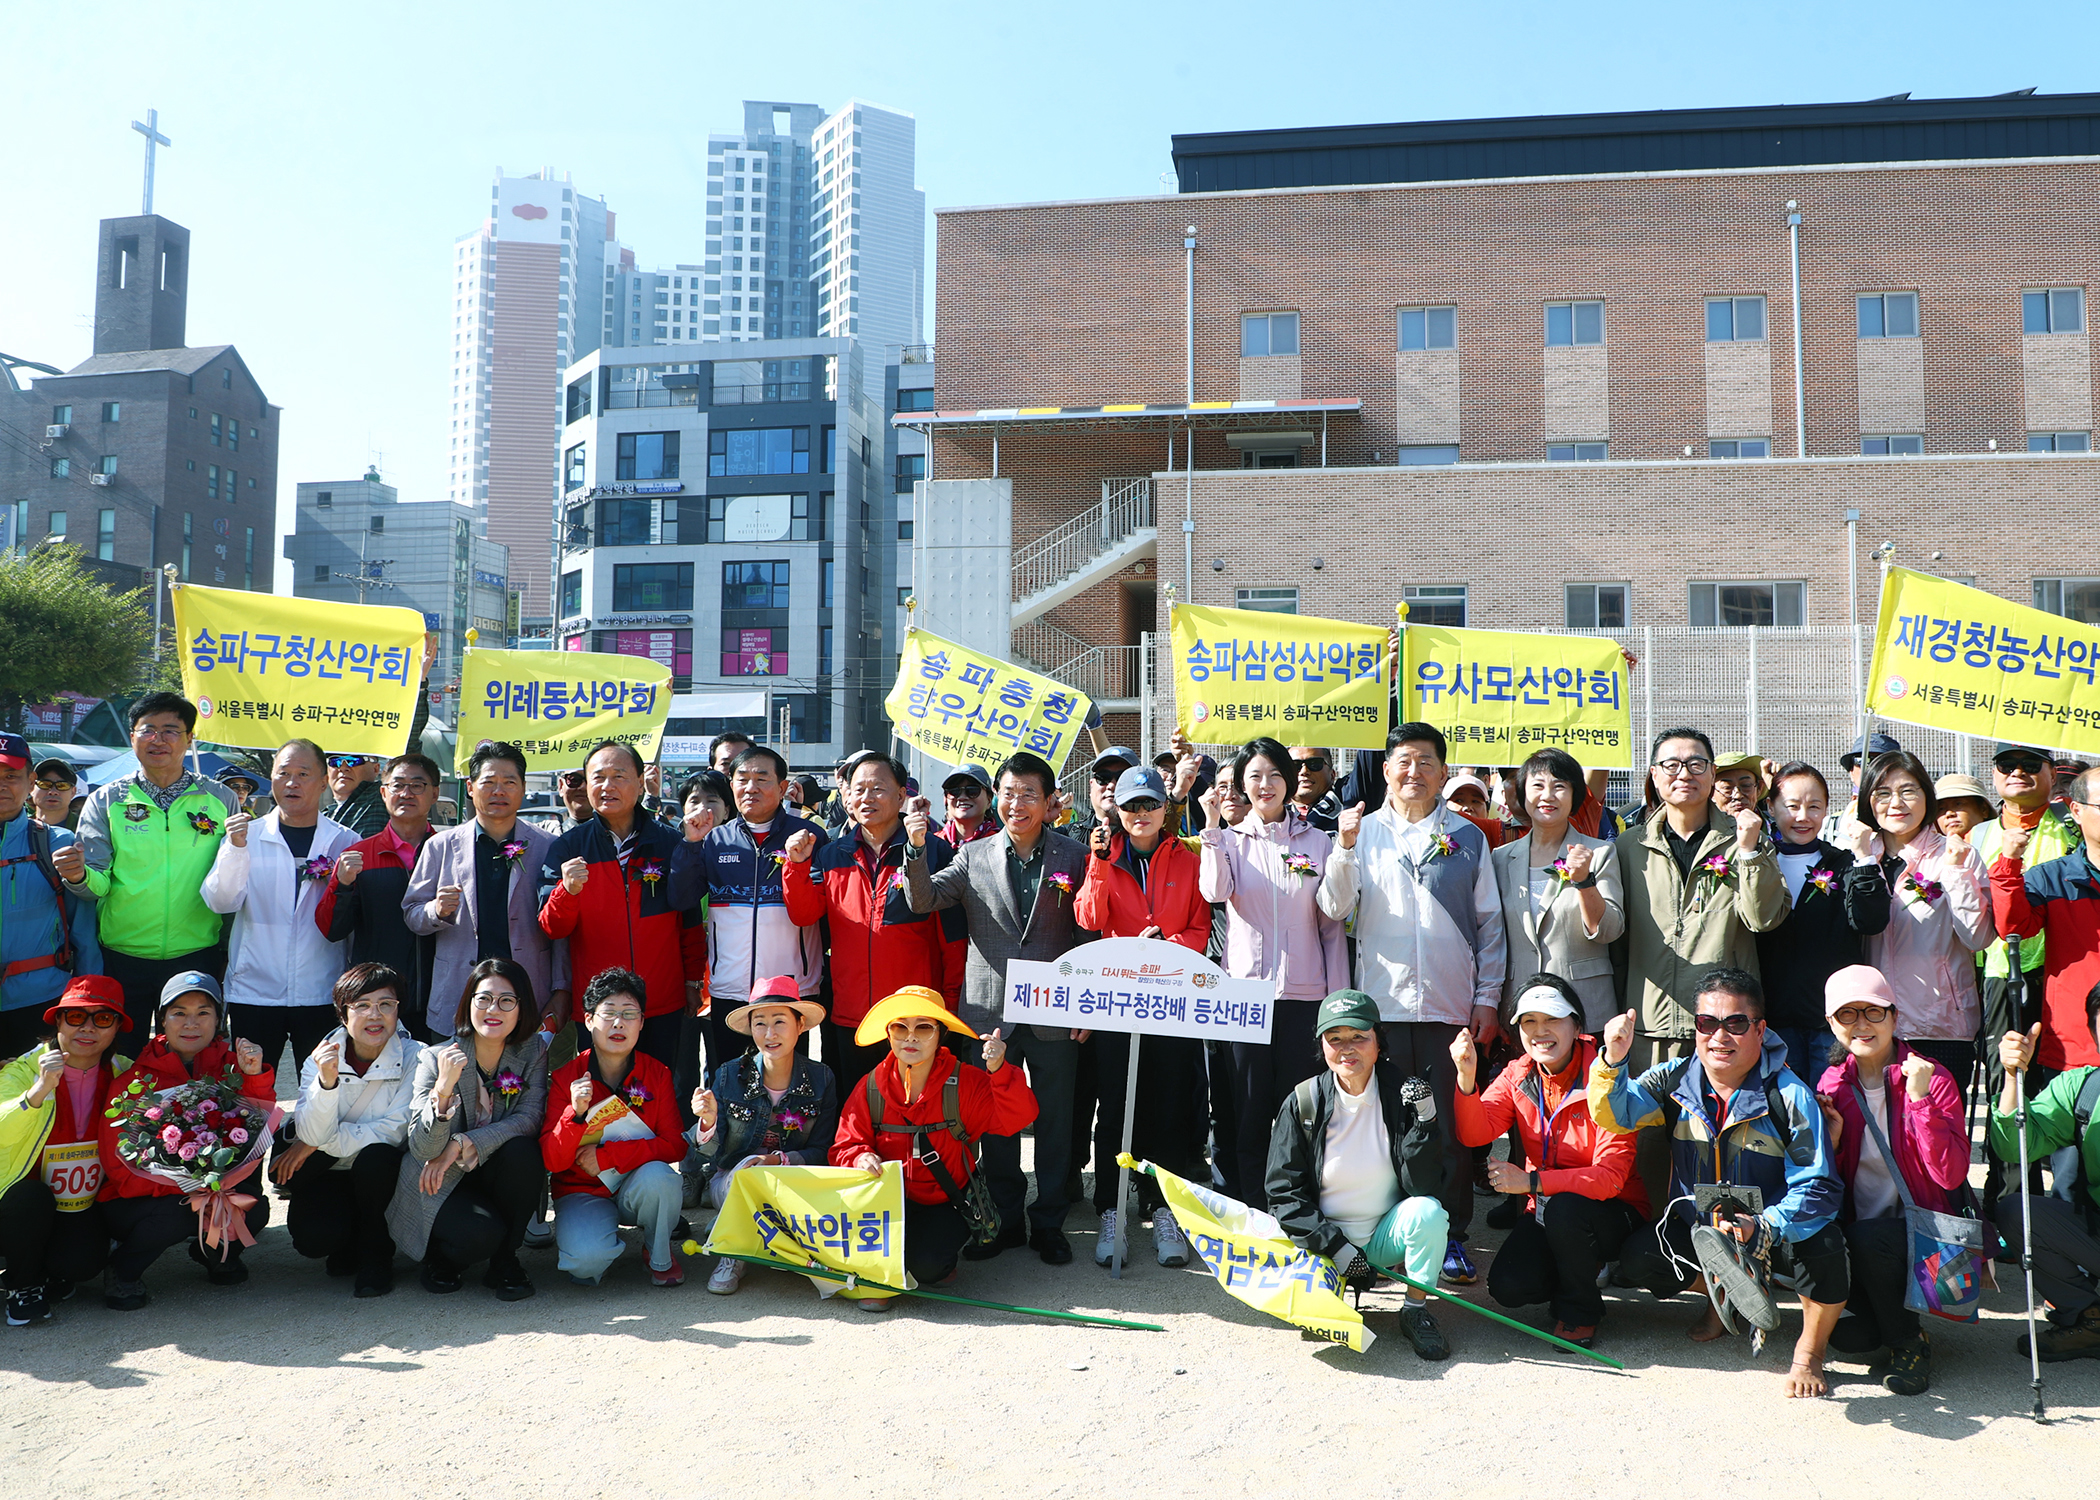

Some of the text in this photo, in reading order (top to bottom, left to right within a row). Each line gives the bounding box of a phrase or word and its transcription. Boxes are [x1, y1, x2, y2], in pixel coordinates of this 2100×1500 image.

[732, 433, 755, 446] 언어
[596, 482, 635, 496] 음악학원
[509, 582, 528, 590] 212
[192, 628, 410, 686] 송파구청산악회
[1187, 638, 1380, 684] 송파삼성산악회
[1416, 660, 1620, 710] 유사모산악회
[484, 680, 656, 720] 위례동산악회
[1913, 683, 1995, 712] 서울특별시
[217, 700, 400, 729] 서울특별시 송파구산악연맹
[907, 683, 1062, 761] 향우산악회
[1212, 704, 1378, 722] 서울특별시 송파구산악연맹
[1442, 726, 1619, 746] 서울특별시 송파구산악연맹
[505, 739, 563, 754] 울특별시
[125, 824, 149, 832] NC
[718, 855, 740, 864] SEOUL
[1076, 968, 1094, 976] 송파구
[1102, 964, 1161, 980] 다시 뛰는 송파!
[1013, 983, 1266, 1029] 제11회 송파구청장배 등산대회
[49, 1152, 64, 1160] 제11회
[66, 1149, 94, 1159] 송파구청장배
[50, 1164, 100, 1194] 503
